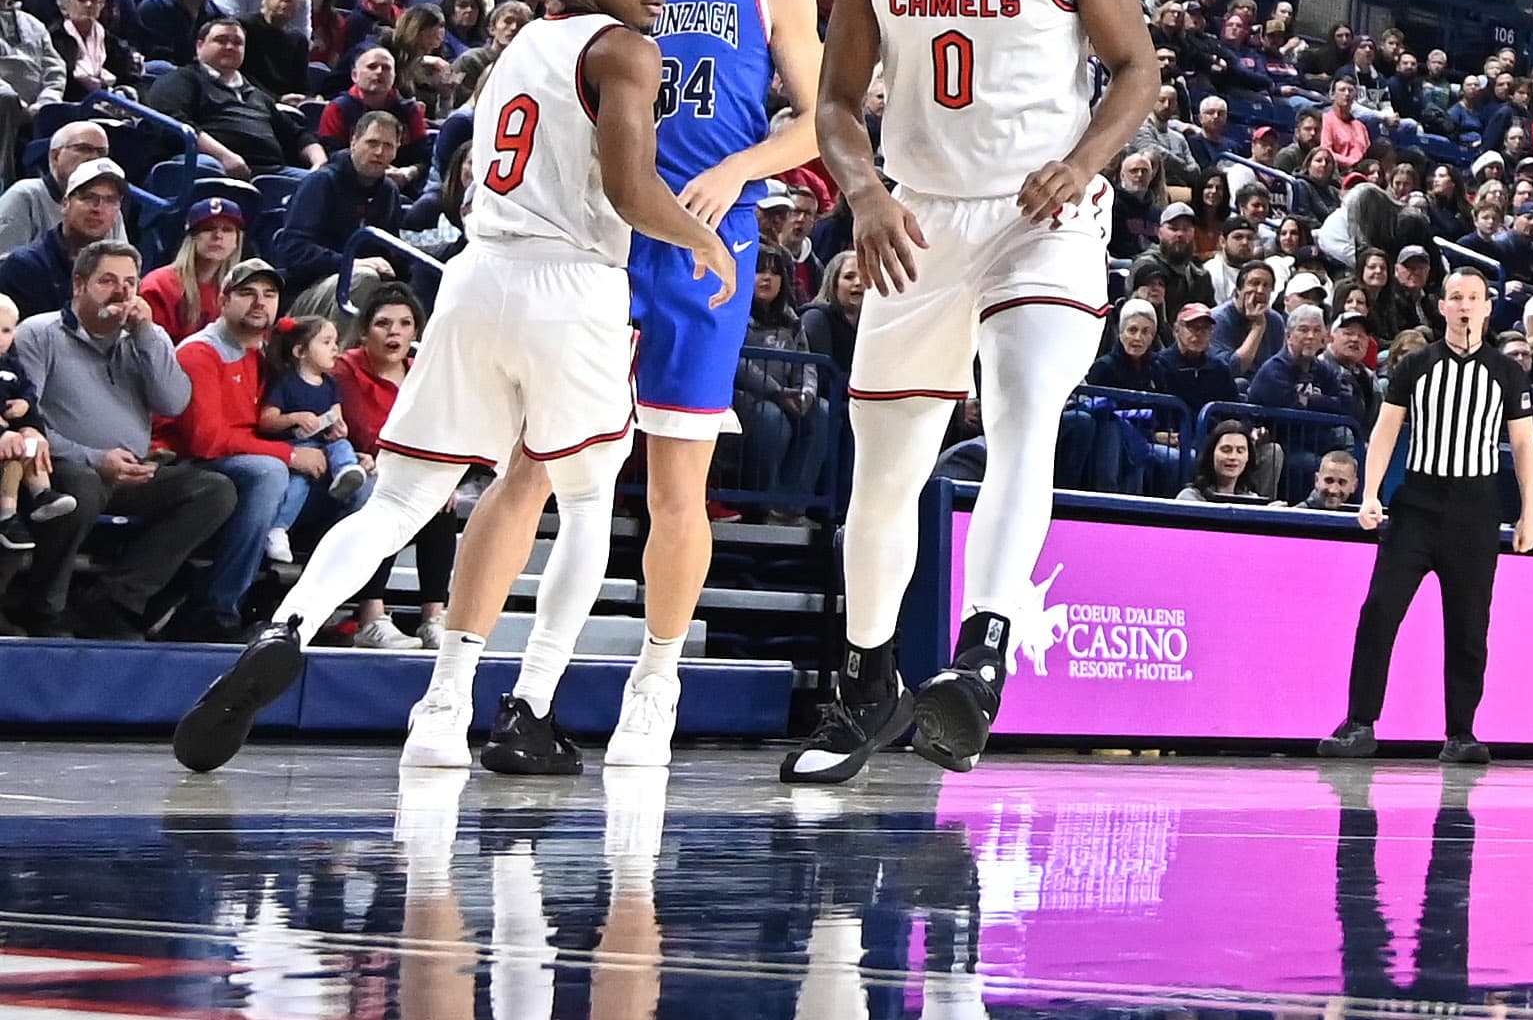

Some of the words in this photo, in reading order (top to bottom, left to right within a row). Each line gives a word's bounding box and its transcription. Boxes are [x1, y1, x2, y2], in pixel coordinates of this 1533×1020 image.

[1494, 26, 1515, 44] 106
[931, 29, 974, 110] 0
[483, 92, 540, 196] 9
[1070, 604, 1122, 623] COEUR
[1067, 623, 1189, 662] CASINO
[1070, 660, 1126, 679] RESORT
